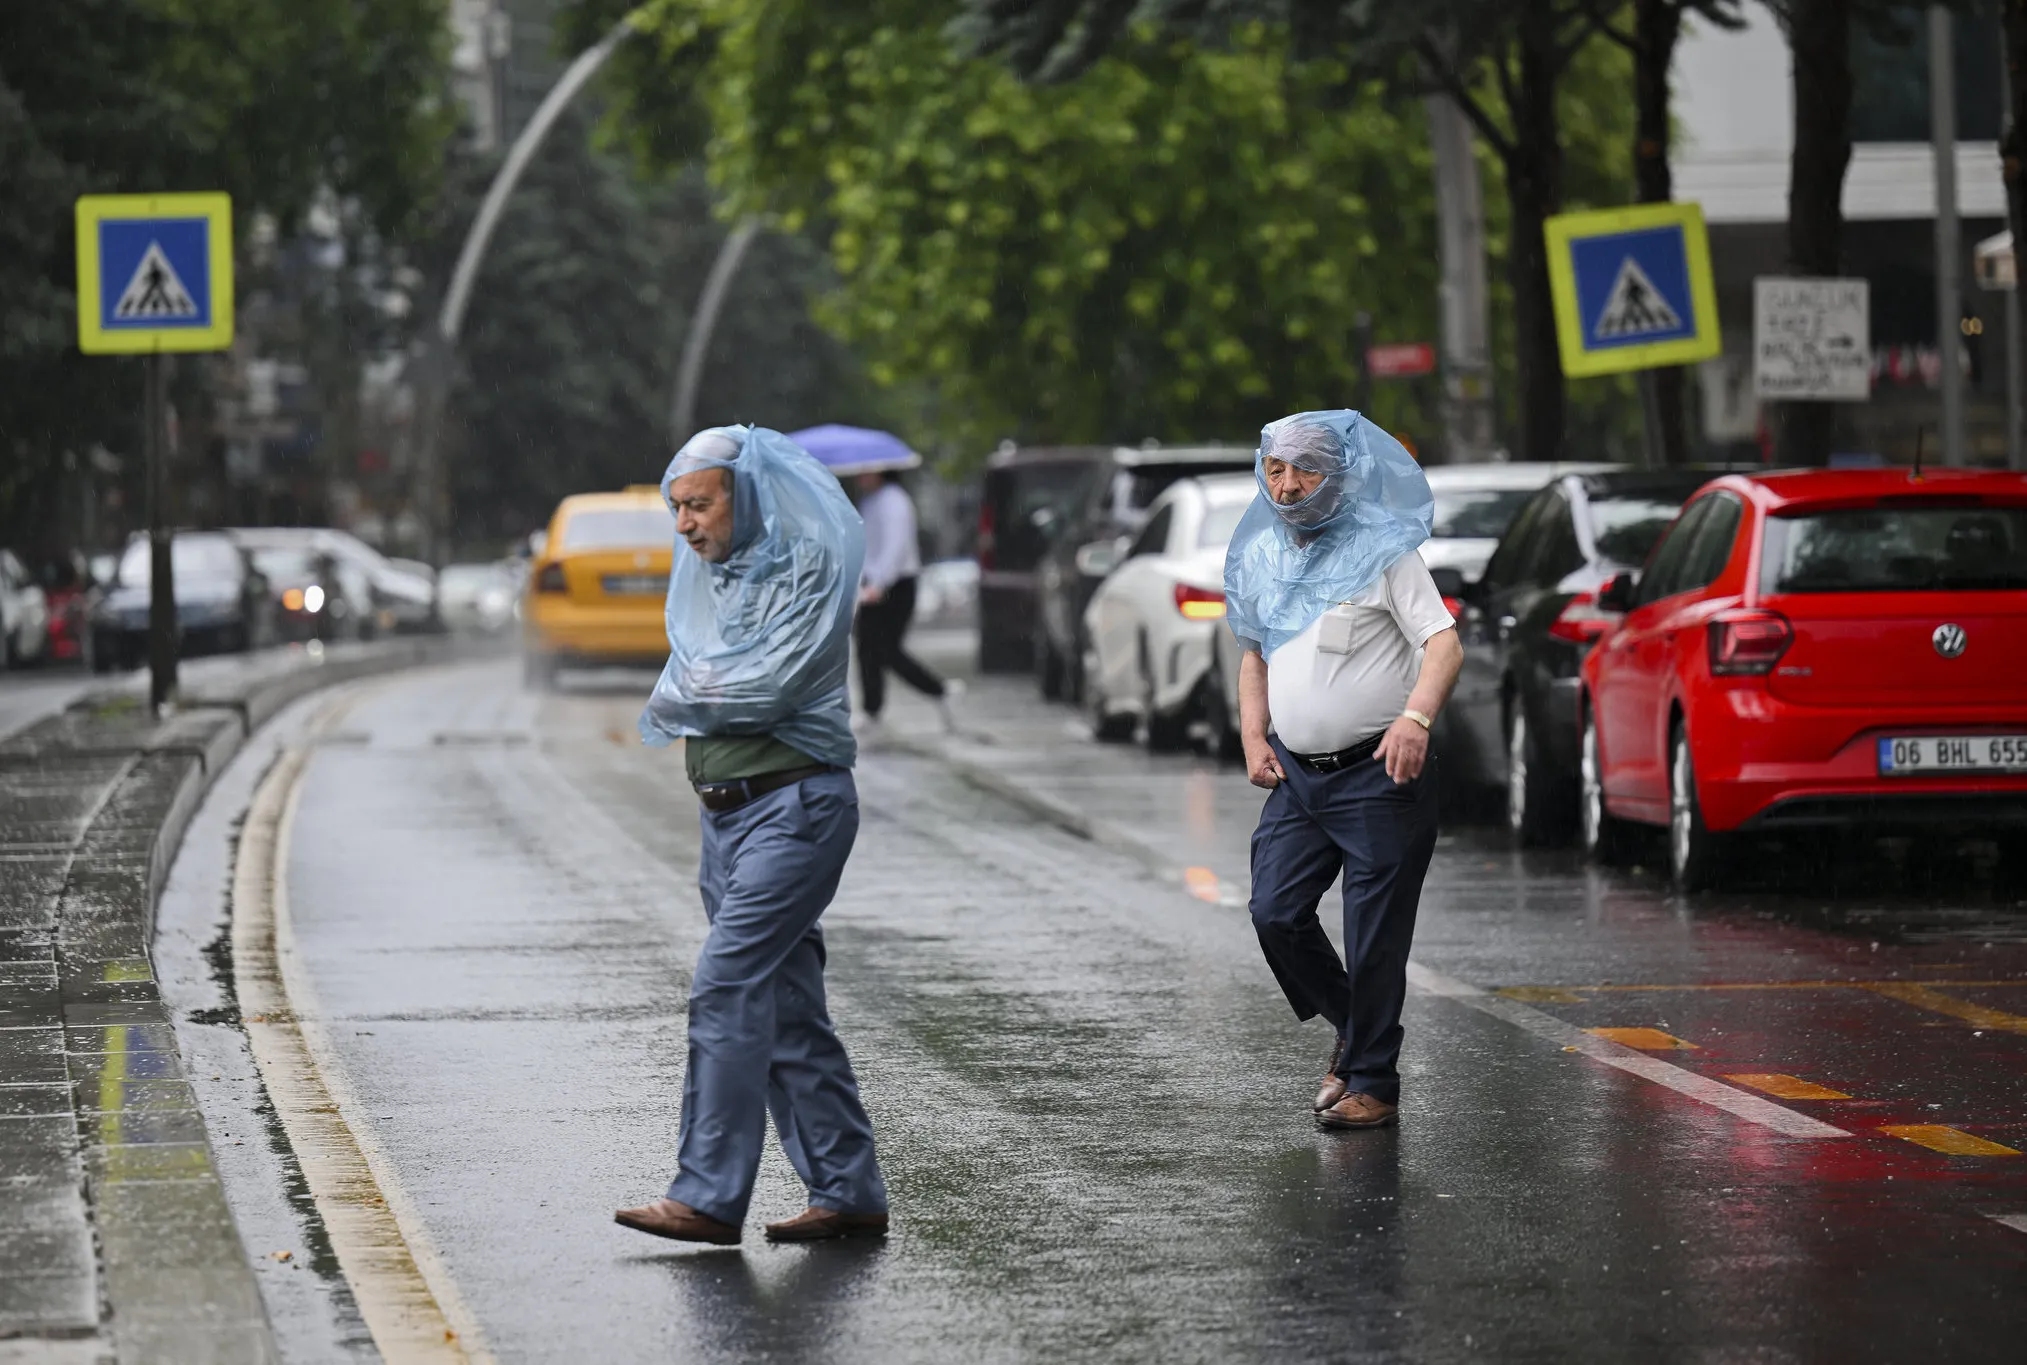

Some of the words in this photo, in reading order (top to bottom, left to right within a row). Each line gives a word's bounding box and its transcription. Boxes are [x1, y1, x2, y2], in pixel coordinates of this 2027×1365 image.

[1895, 741, 1921, 765] 06
[1936, 740, 1977, 764] BHL
[1988, 739, 2027, 763] 655
